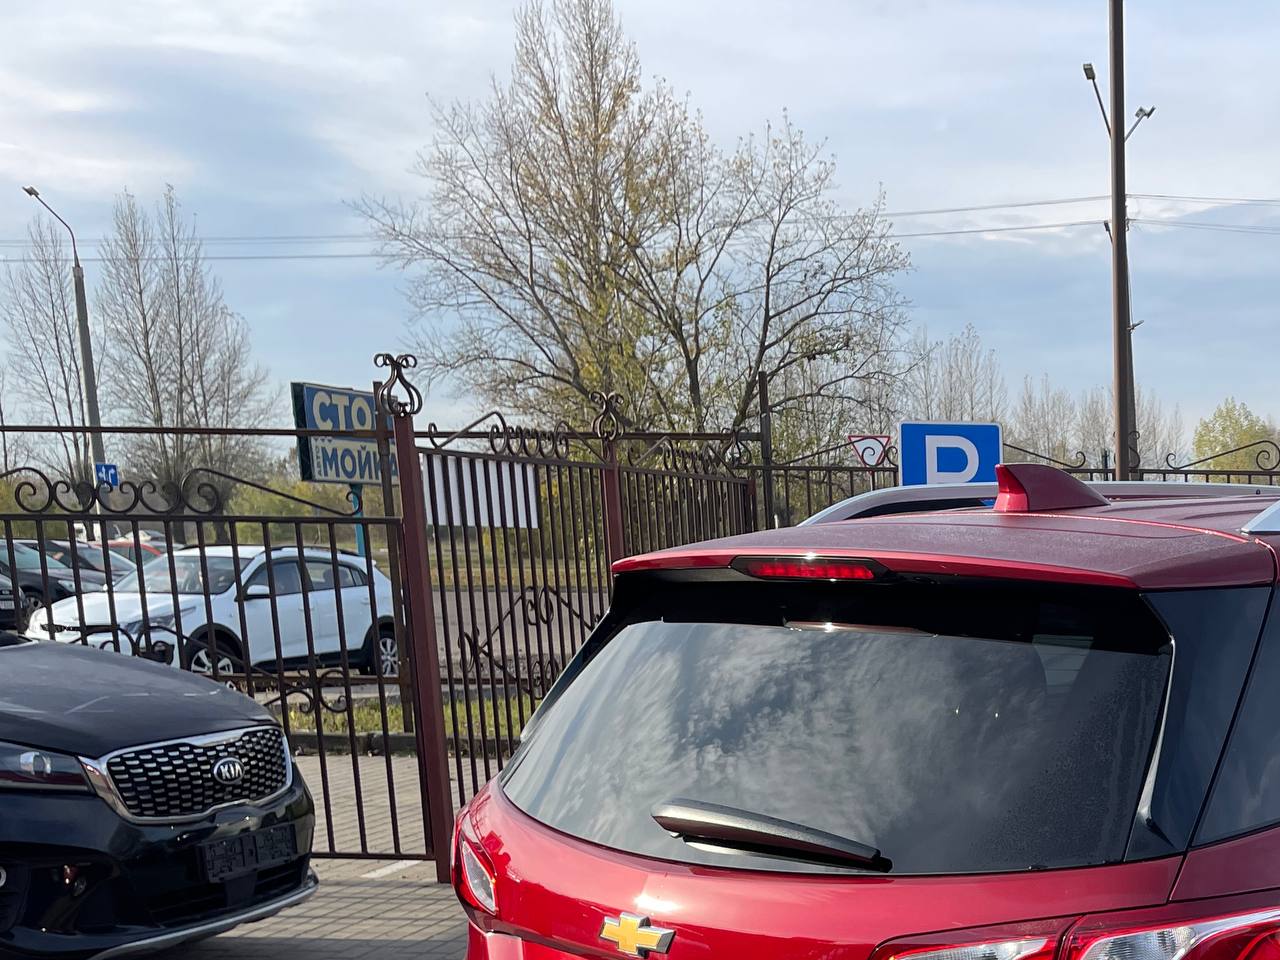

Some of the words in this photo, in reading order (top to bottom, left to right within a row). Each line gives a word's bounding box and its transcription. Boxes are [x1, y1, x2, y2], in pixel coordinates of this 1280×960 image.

[313, 391, 372, 432] СТО
[925, 435, 980, 485] P
[220, 763, 242, 780] KIA
